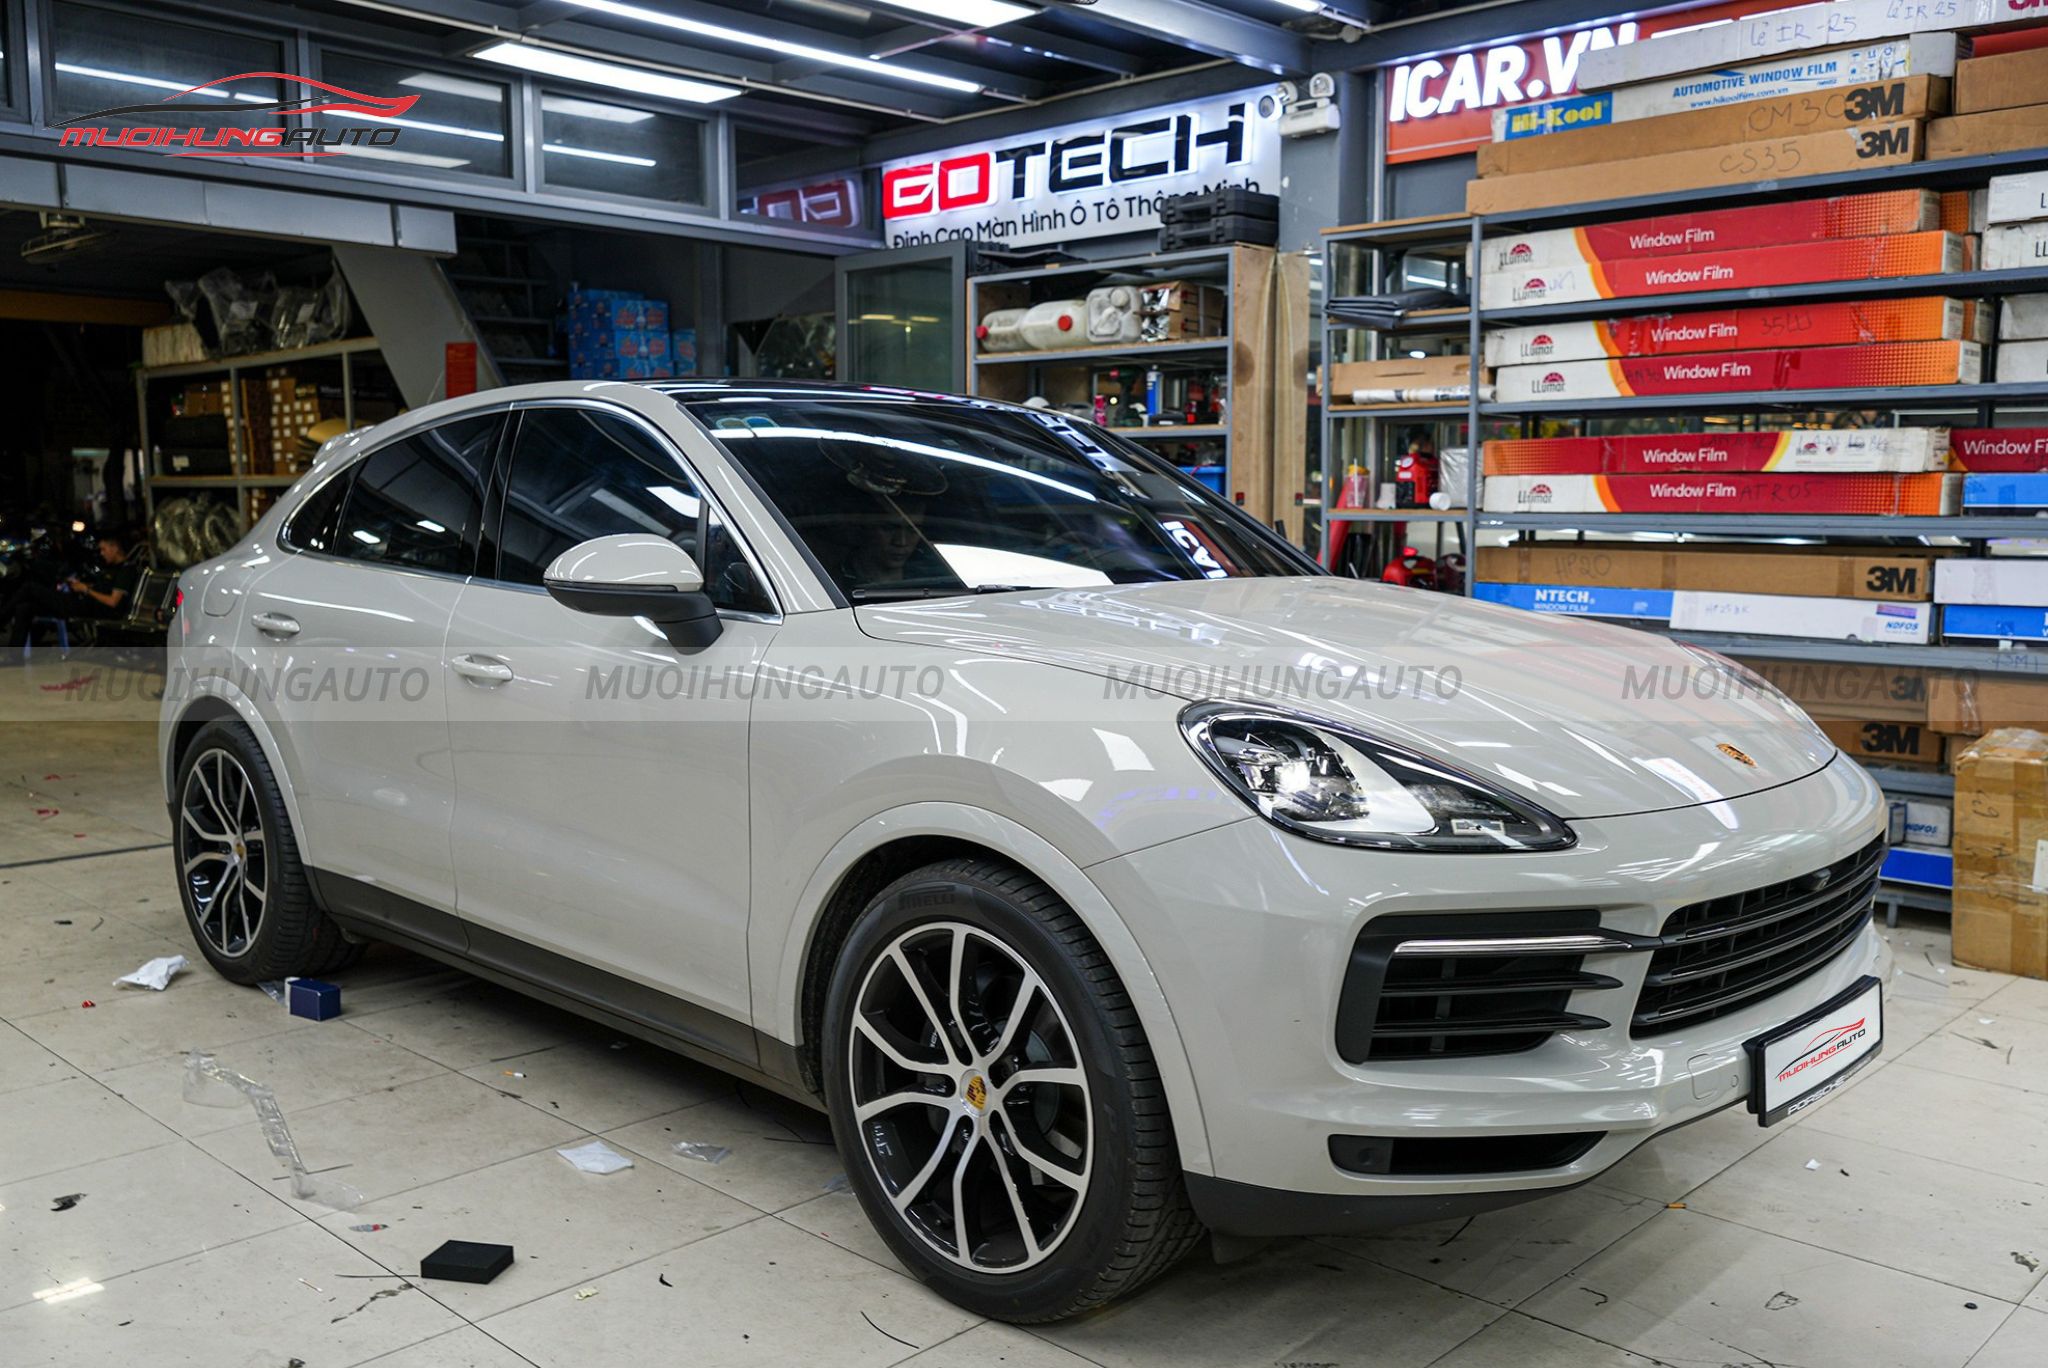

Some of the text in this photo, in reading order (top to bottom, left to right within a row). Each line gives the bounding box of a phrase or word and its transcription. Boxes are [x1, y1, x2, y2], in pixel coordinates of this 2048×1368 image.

[1673, 75, 1745, 98] AUTOMOTIVE
[1750, 68, 1804, 84] WINDOW
[1807, 61, 1837, 76] FILM
[1844, 82, 1906, 121] 3M
[1511, 101, 1603, 133] Hi-Kool
[1856, 127, 1909, 158] 3M
[1720, 140, 1801, 174] CS35
[935, 227, 973, 244] Cao
[977, 216, 1017, 241] Màn
[1022, 208, 1065, 234] Hình
[1070, 199, 1087, 226] Ô
[1093, 196, 1120, 221] Tô
[1630, 228, 1715, 250] Window Film
[1646, 264, 1734, 285] Window Film
[1651, 322, 1738, 342] Window Film
[1663, 364, 1719, 380] Window
[1721, 361, 1751, 376] Film
[1643, 446, 1728, 464] Window Film
[1963, 438, 2032, 456] Window
[1650, 482, 1737, 499] Window Film
[1554, 552, 1612, 580] HP20
[1866, 566, 1918, 594] 3M
[1535, 589, 1590, 603] NTECH
[1860, 723, 1920, 755] 3M
[1778, 1028, 1866, 1083] MUOIHUNGAUTO
